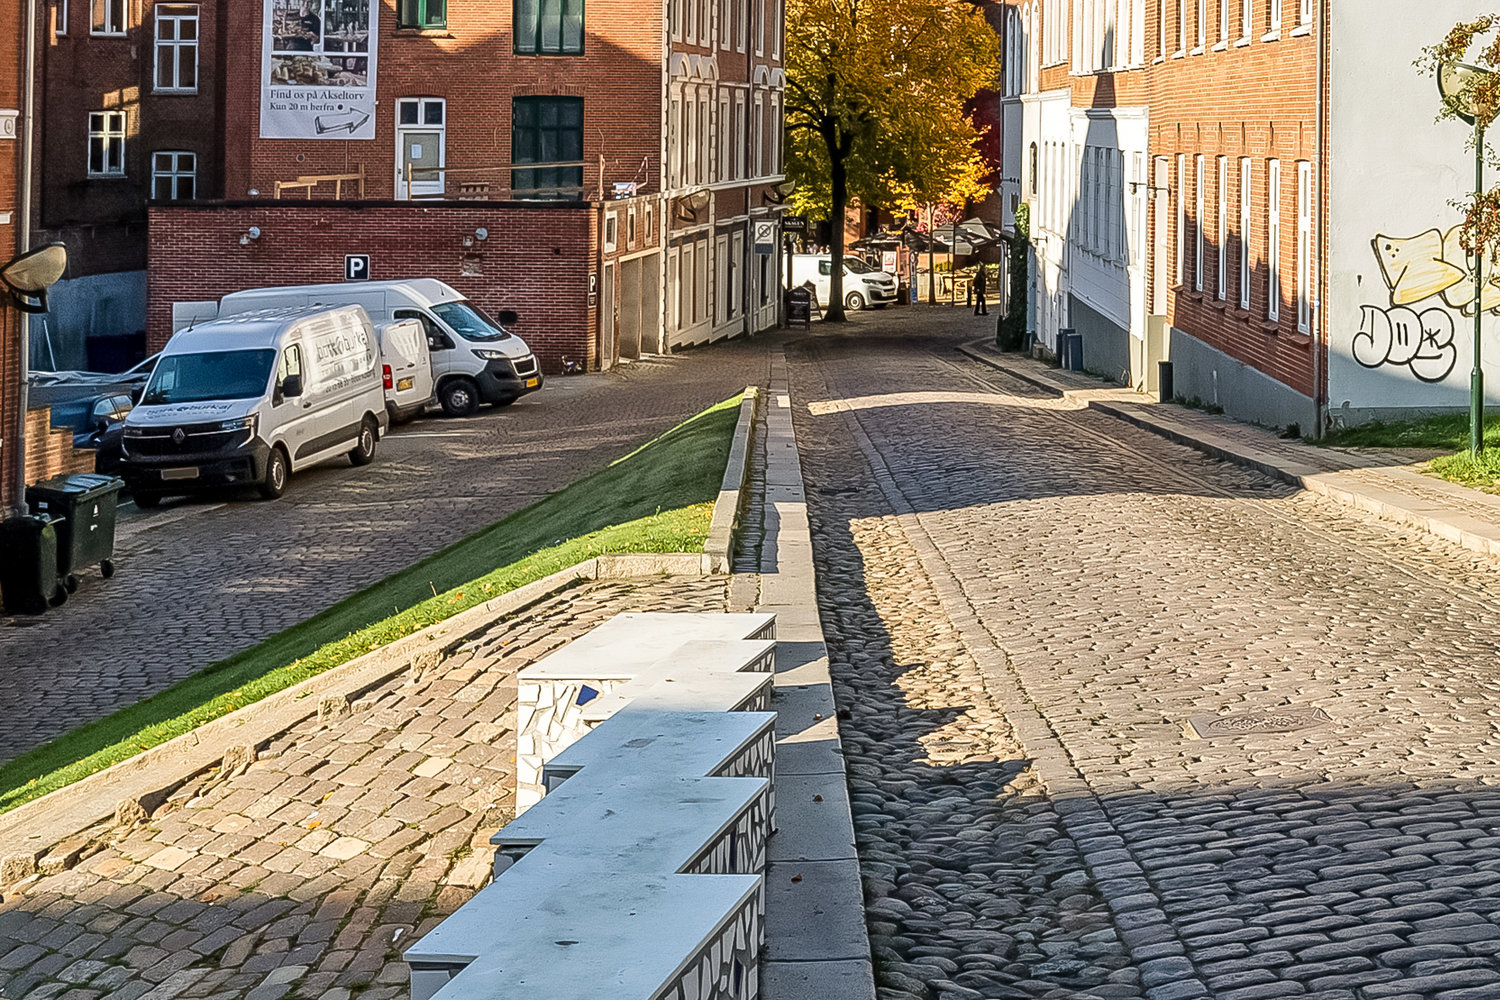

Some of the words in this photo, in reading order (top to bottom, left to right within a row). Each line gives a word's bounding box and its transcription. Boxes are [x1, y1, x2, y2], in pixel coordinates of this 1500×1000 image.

[270, 90, 291, 99] Find
[306, 90, 318, 101] på
[320, 90, 365, 100] Akseltorv
[270, 102, 286, 110] Kun
[289, 102, 299, 110] 20
[310, 102, 335, 111] herfra
[350, 257, 364, 278] P
[590, 275, 596, 292] P
